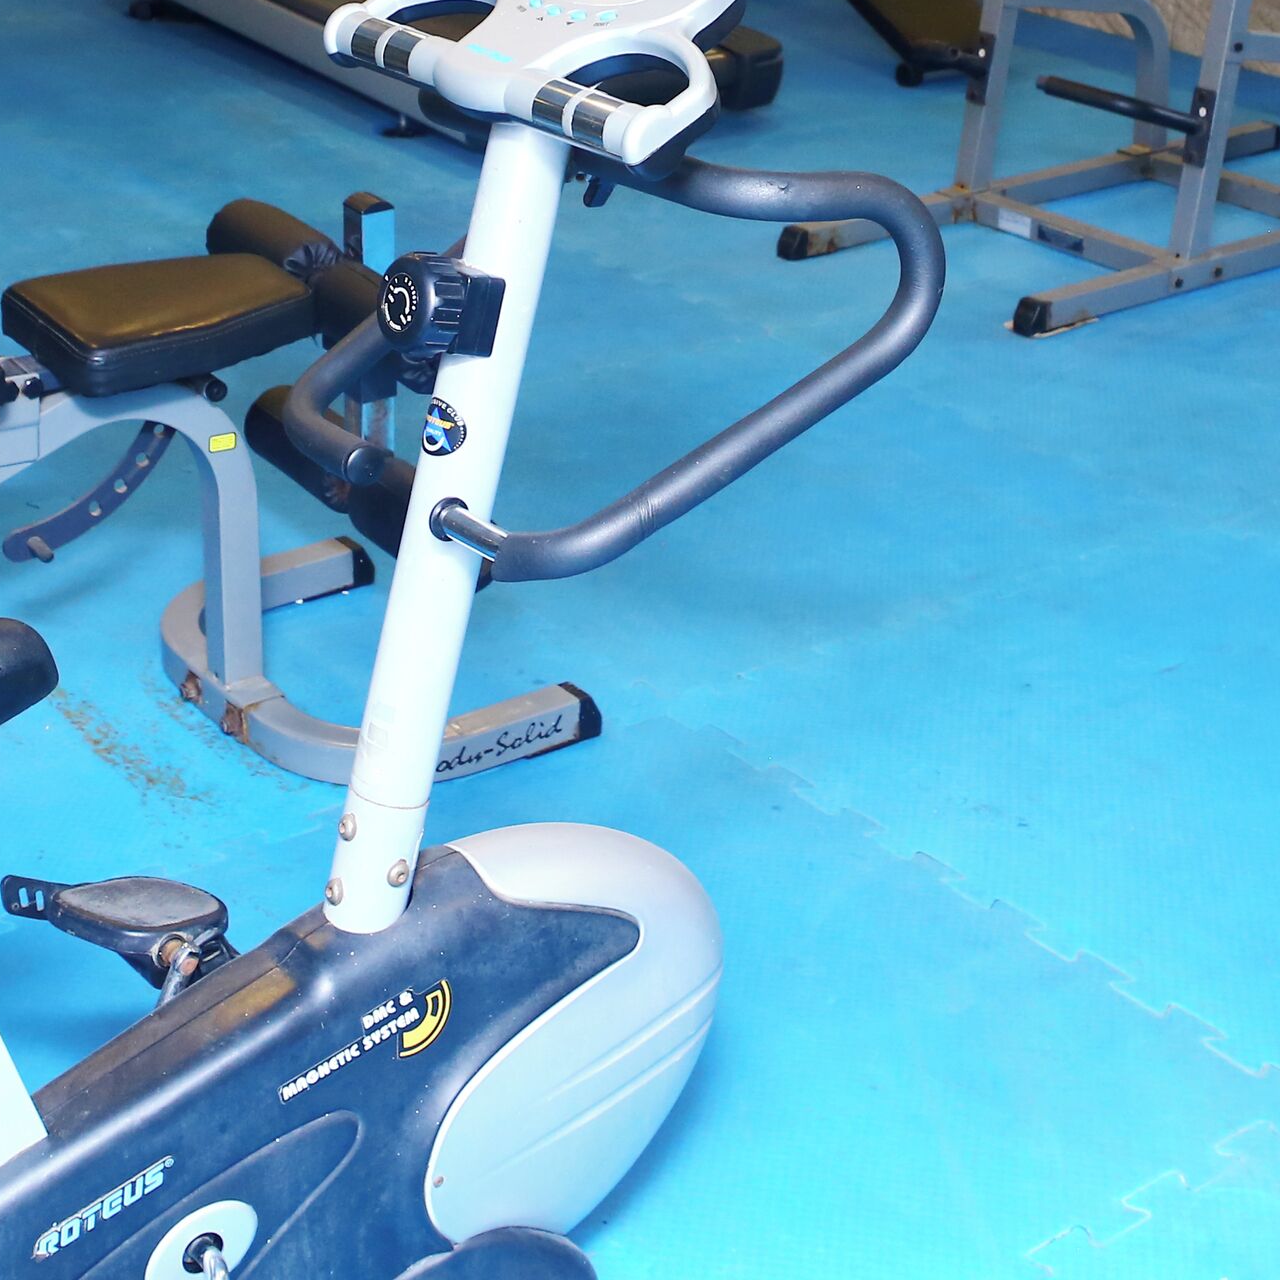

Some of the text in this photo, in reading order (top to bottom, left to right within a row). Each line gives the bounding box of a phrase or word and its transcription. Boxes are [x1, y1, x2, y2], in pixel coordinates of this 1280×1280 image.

[446, 407, 464, 426] CLUB
[361, 999, 398, 1031] DMC
[281, 1006, 421, 1102] MAGNETIC SYSTEM
